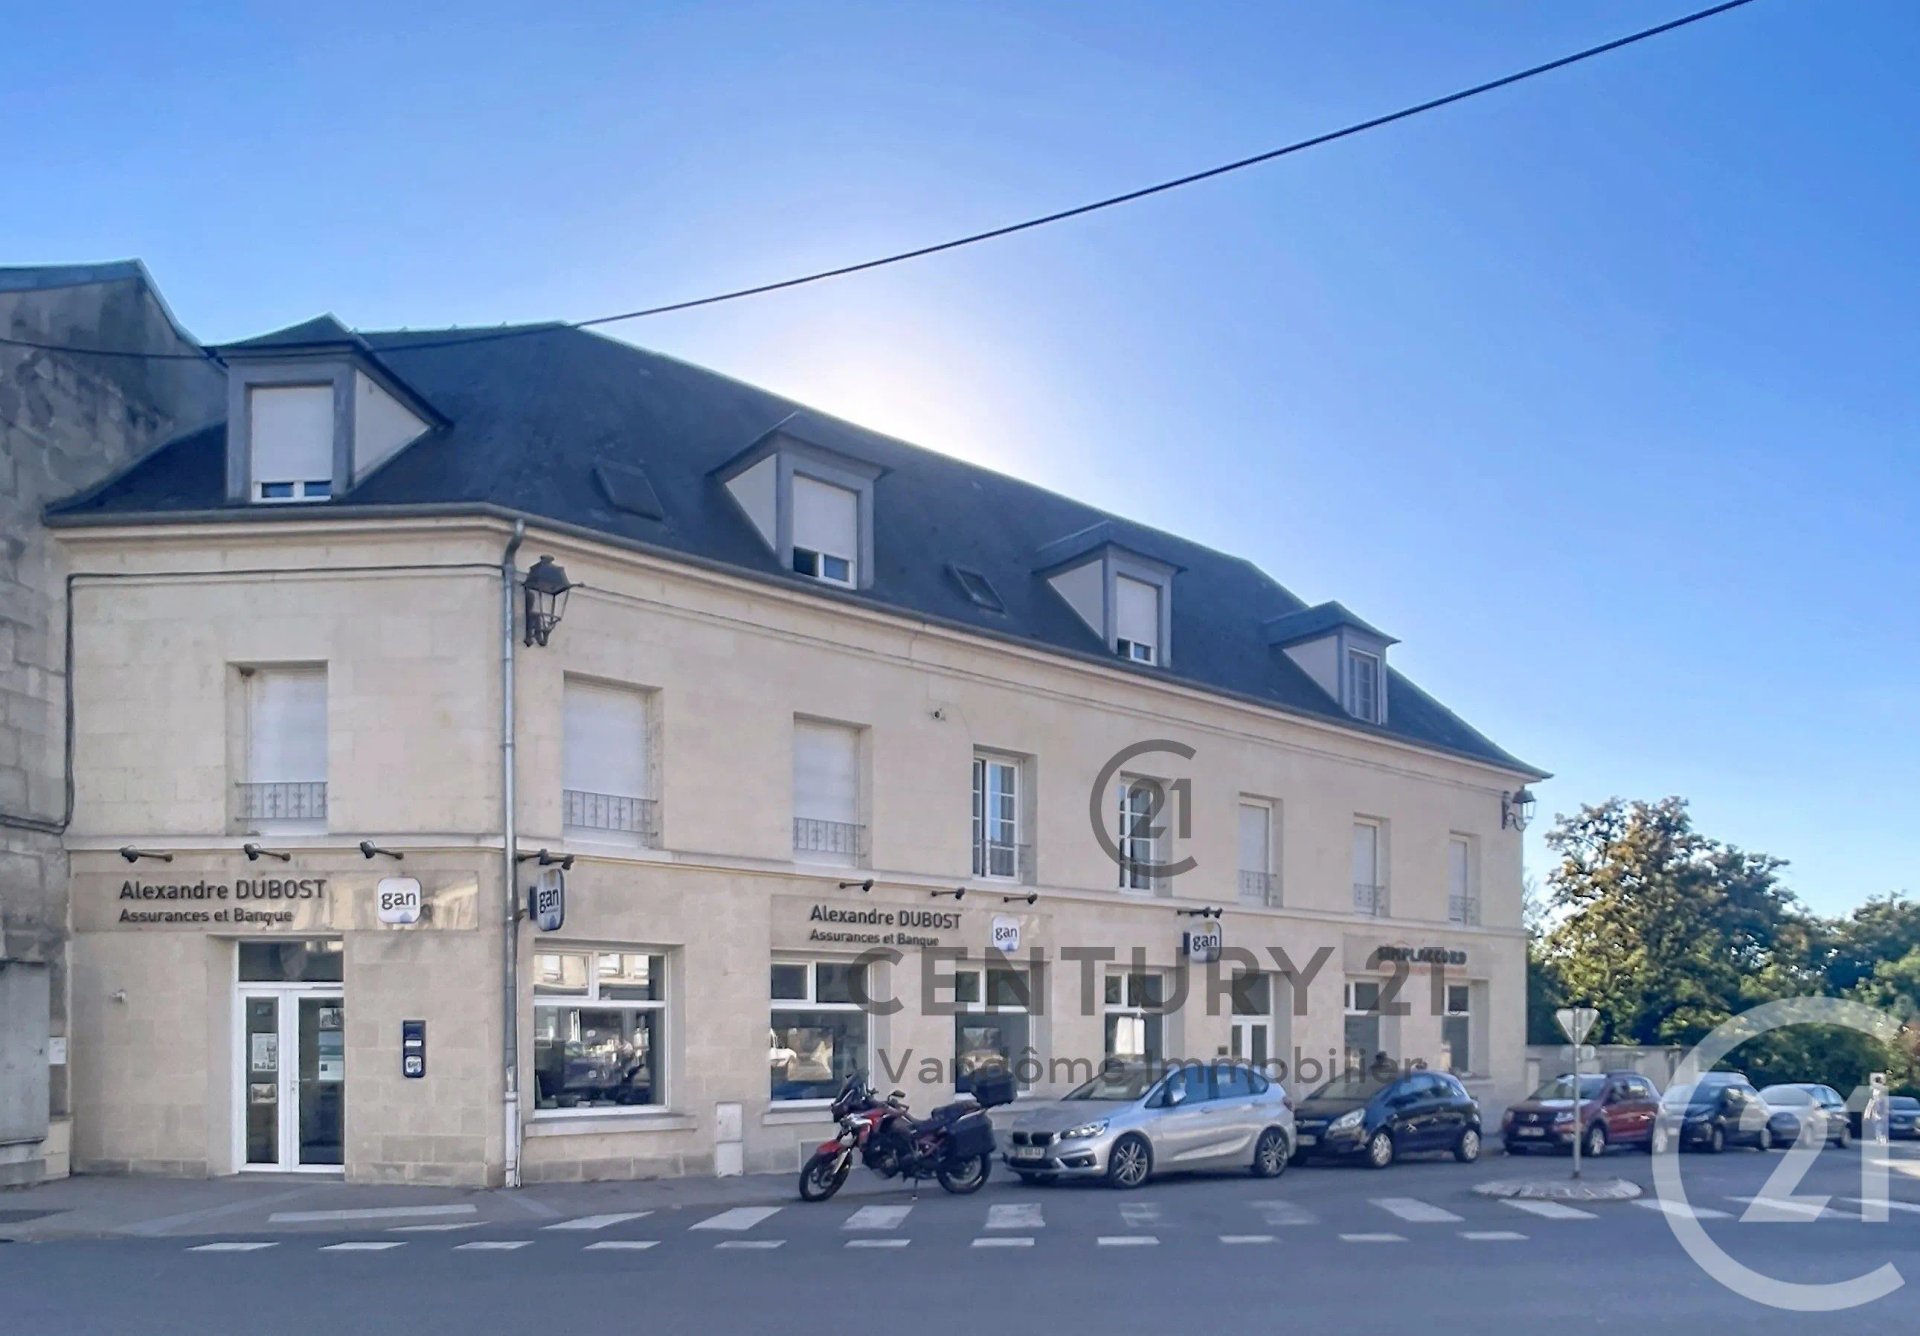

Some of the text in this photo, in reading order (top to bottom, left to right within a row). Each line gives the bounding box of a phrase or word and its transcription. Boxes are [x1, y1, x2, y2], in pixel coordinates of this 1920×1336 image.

[119, 879, 327, 900] Alexandre DUBOST
[381, 892, 416, 911] gan
[538, 888, 560, 914] gan
[119, 908, 293, 926] Assurances et Banque
[810, 904, 962, 930] Alexandre DUBOST
[810, 928, 940, 949] Assurances et Banque
[995, 927, 1018, 941] gan
[1192, 935, 1217, 952] gan
